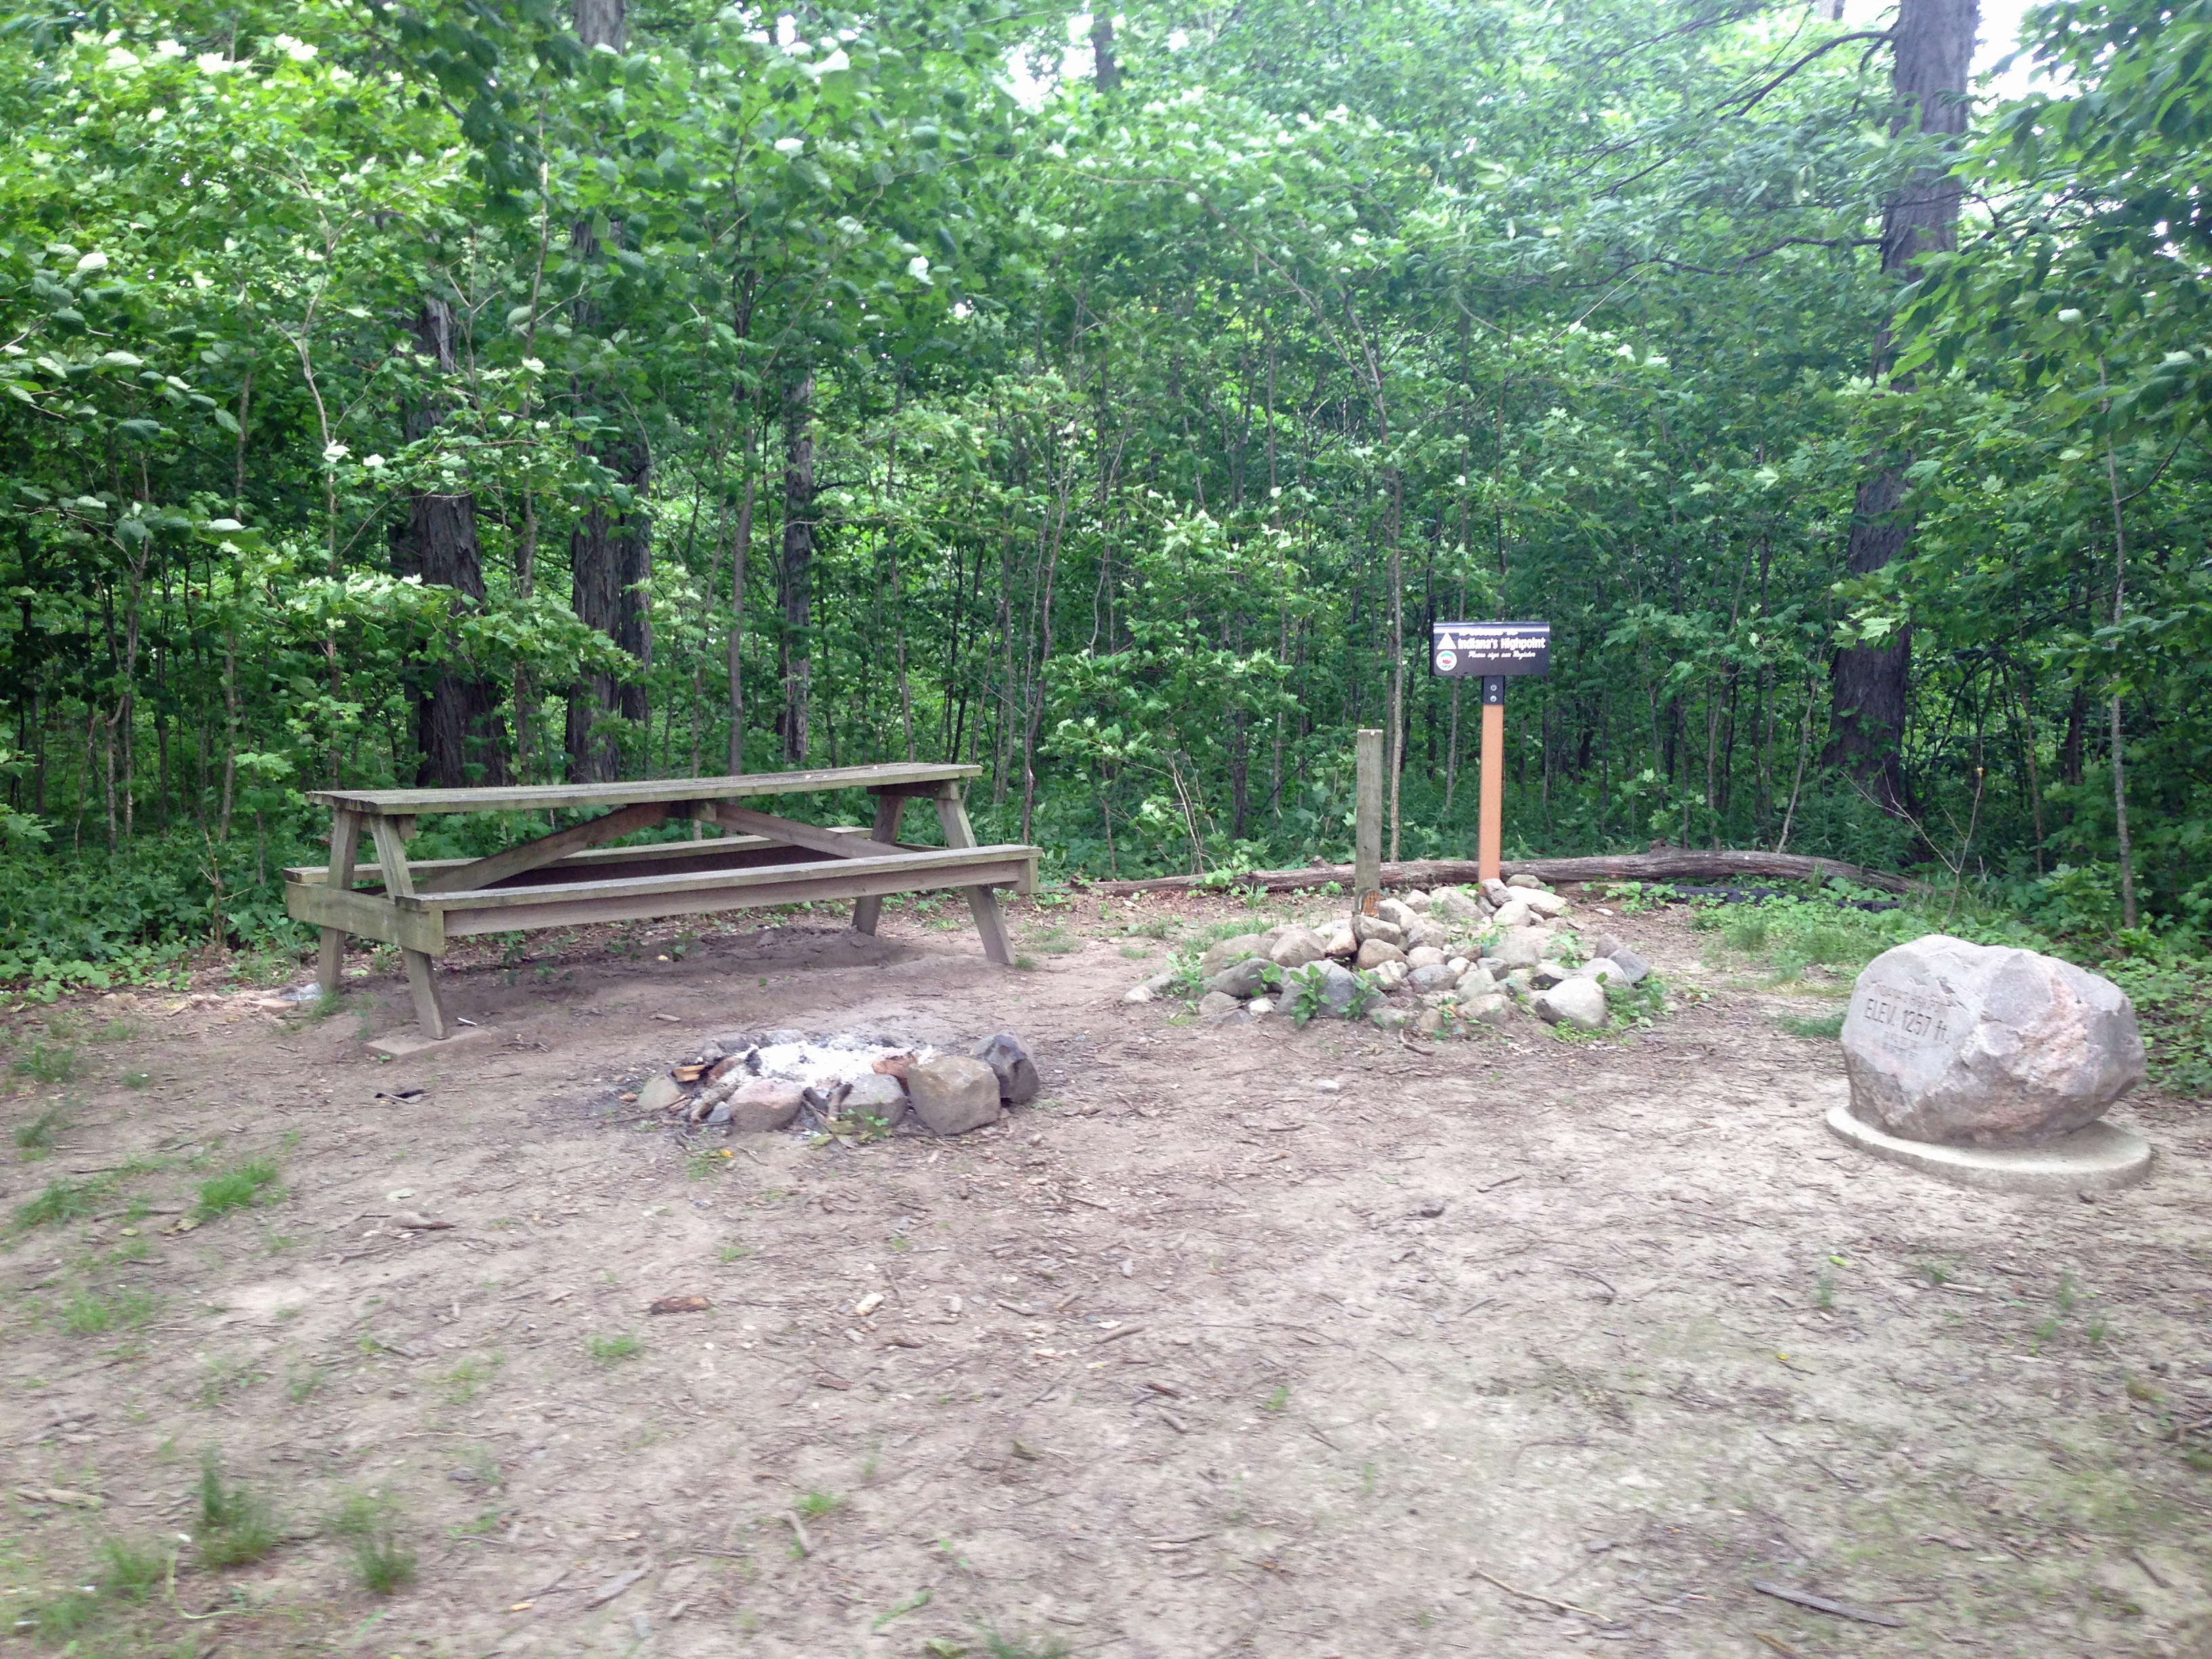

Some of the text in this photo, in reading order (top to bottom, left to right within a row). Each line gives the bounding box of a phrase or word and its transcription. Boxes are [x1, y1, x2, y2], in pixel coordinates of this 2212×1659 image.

[1458, 636, 1545, 651] Indiana's Highpoint
[1902, 1009, 1932, 1037] 1257
